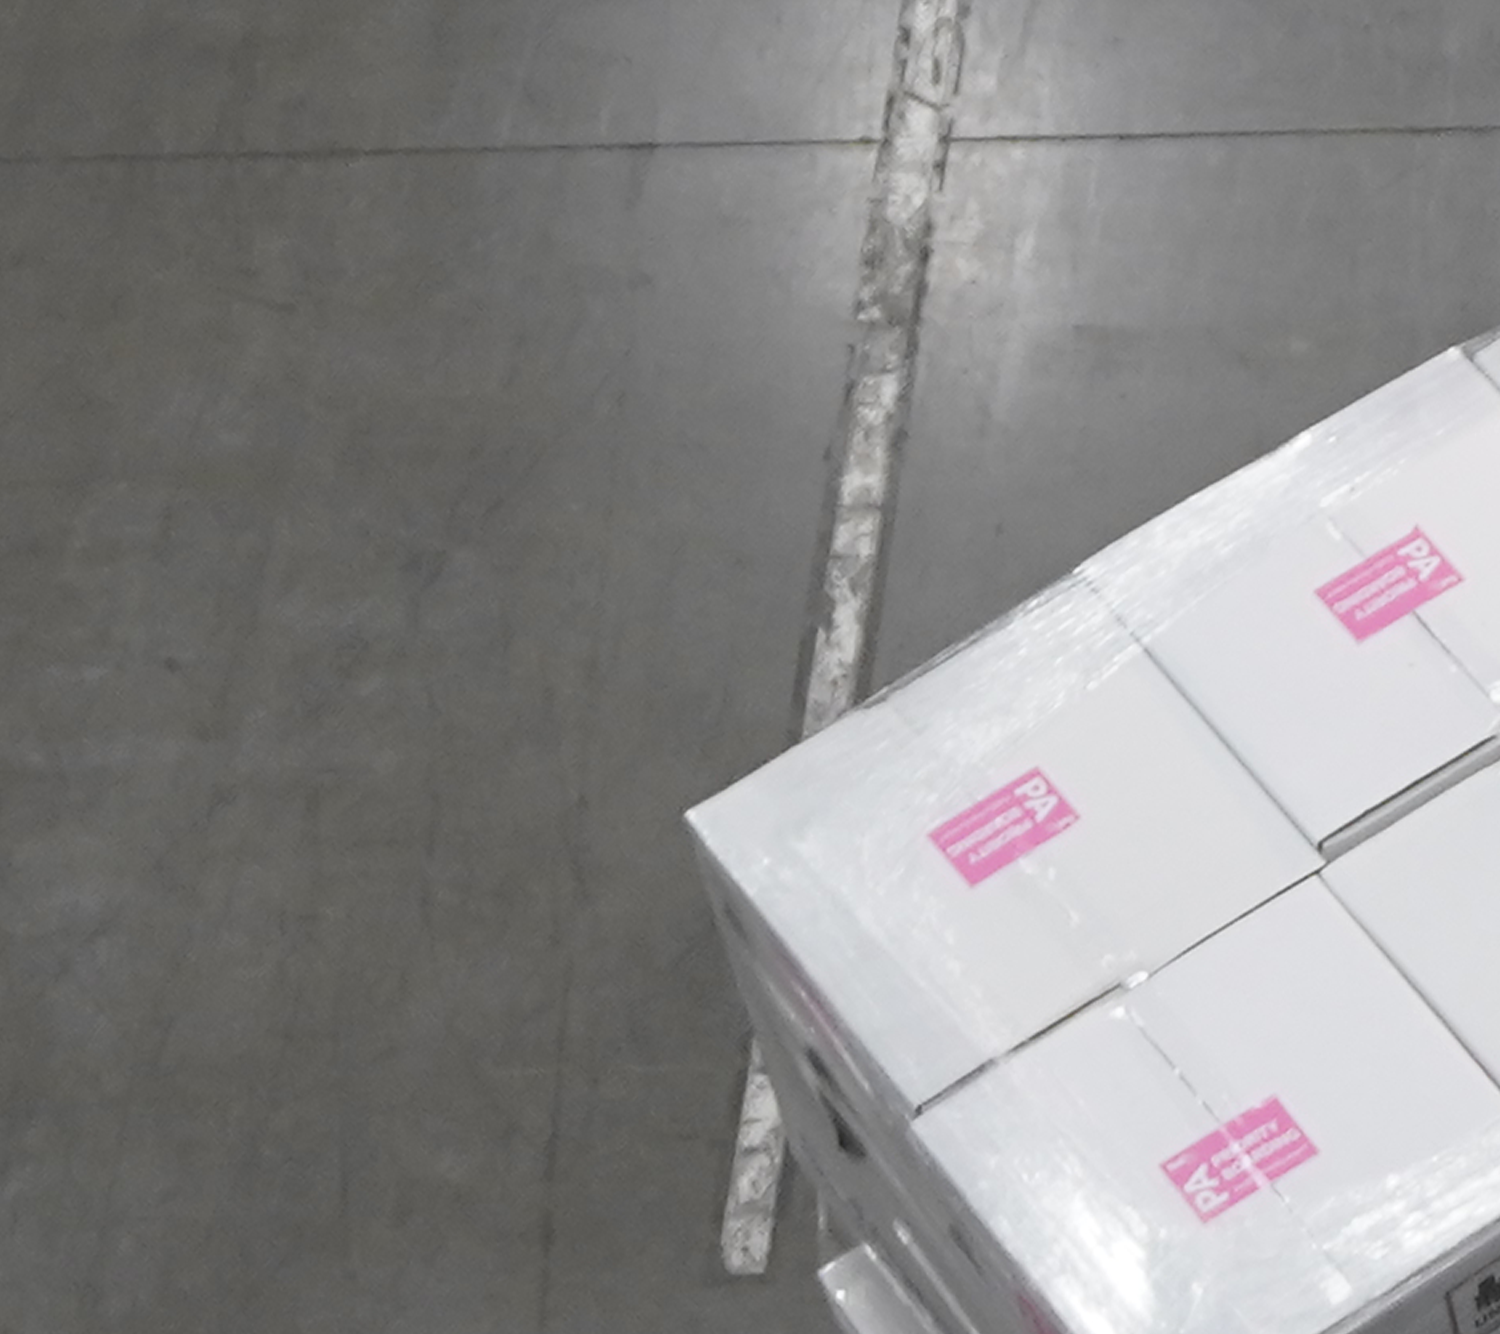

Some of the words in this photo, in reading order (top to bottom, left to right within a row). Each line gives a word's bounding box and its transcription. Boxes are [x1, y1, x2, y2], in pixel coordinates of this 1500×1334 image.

[1397, 537, 1441, 581] PA
[1013, 776, 1059, 823] PA
[1183, 1161, 1230, 1212] PA
